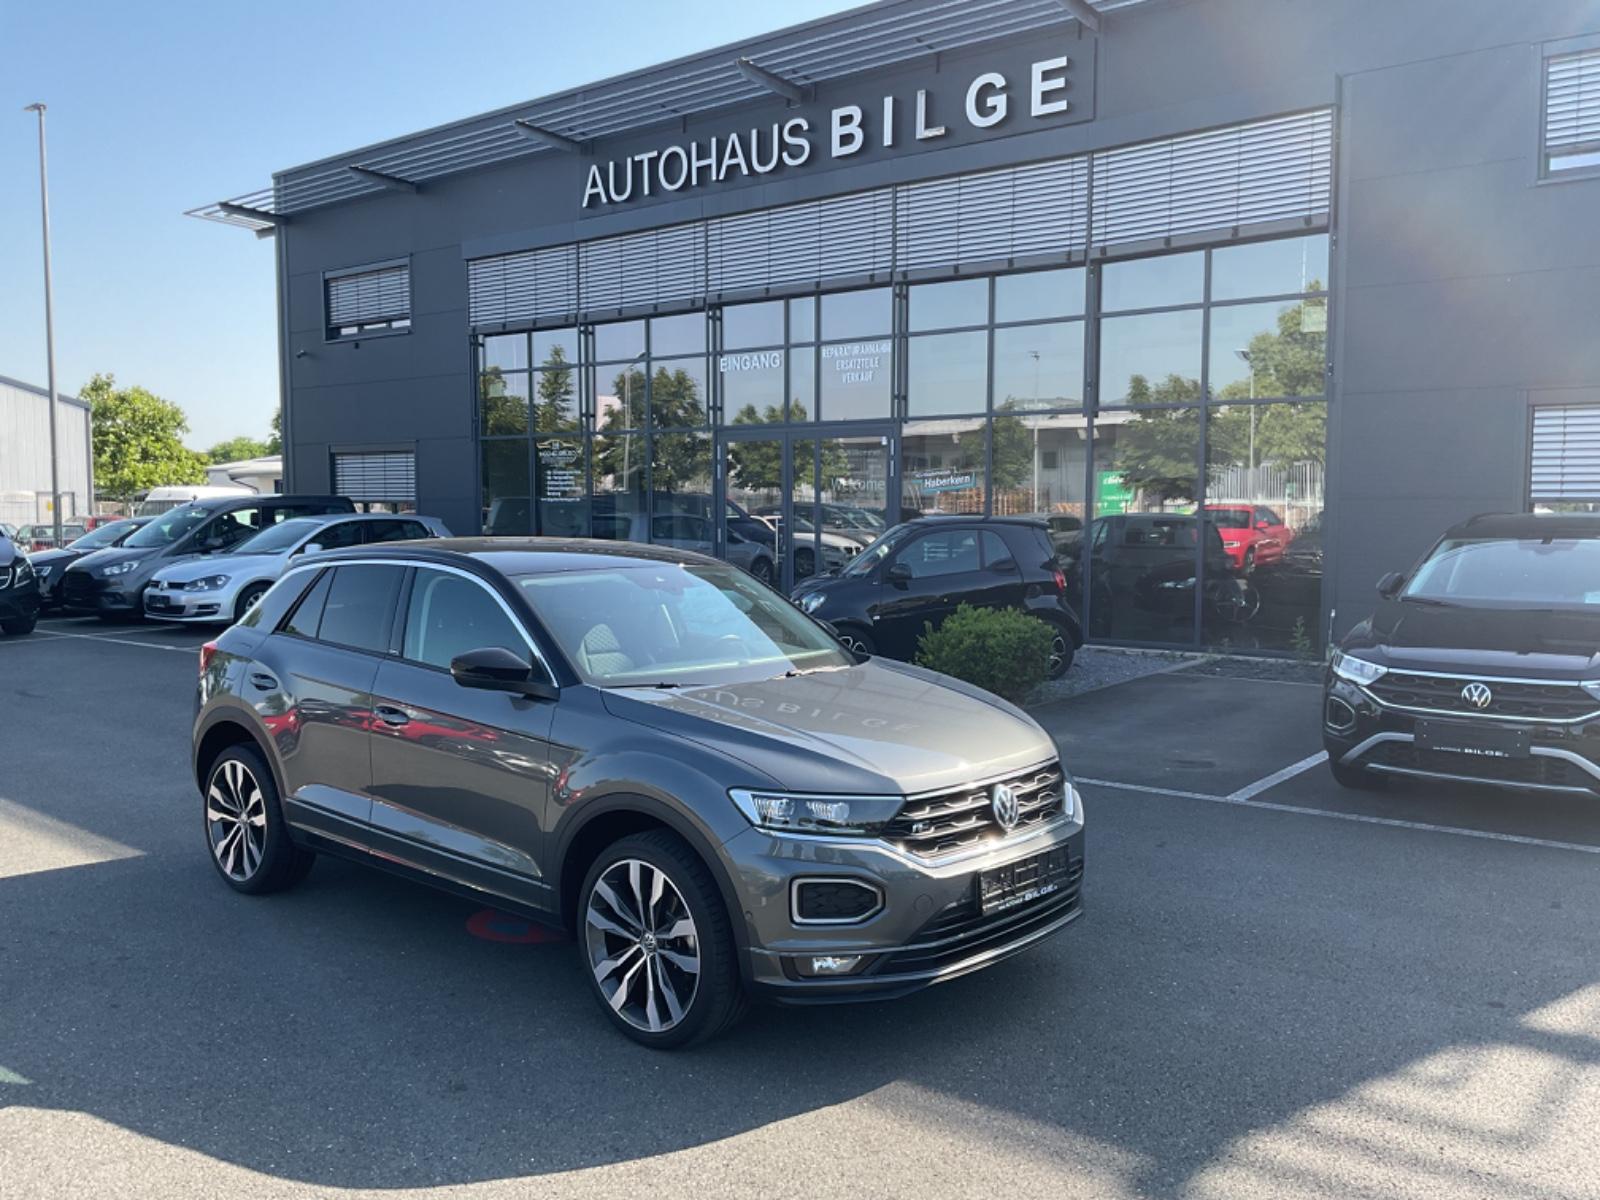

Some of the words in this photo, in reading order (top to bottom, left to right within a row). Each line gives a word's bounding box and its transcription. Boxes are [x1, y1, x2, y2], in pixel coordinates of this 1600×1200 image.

[582, 117, 810, 208] AUTOHAUS
[829, 55, 1069, 159] BILGE
[720, 352, 782, 372] EINGANG
[924, 475, 971, 488] Haberkern
